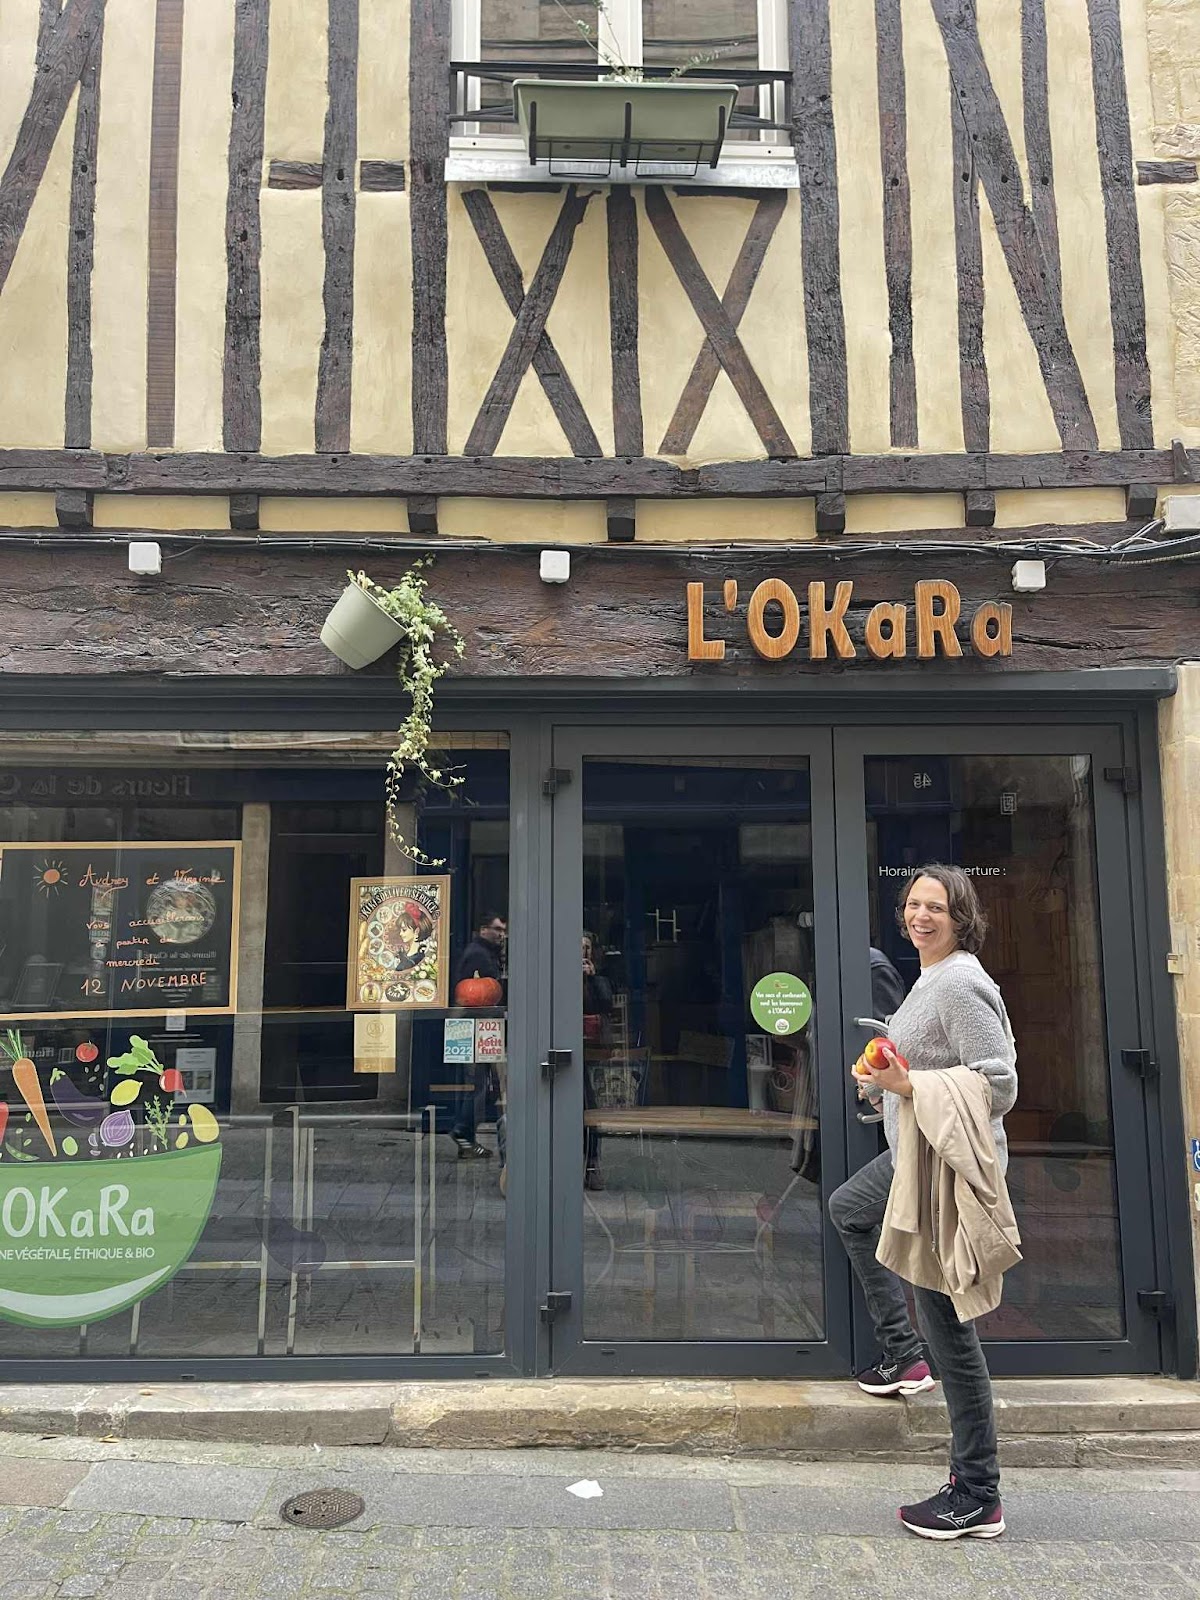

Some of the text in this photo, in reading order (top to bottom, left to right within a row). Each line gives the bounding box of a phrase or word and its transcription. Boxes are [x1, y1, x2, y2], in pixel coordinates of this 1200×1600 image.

[686, 577, 1013, 662] L'OKaRa
[79, 863, 129, 900] Audrey
[146, 873, 160, 885] et
[106, 957, 160, 968] mercredi
[80, 978, 106, 996] 12
[120, 971, 207, 993] NOVEMBRE
[479, 1021, 501, 1031] 2021
[445, 1046, 471, 1055] 2022
[2, 1184, 155, 1238] OKaRa
[16, 1247, 71, 1261] VÉGÉTALE,
[74, 1247, 122, 1260] ÉTHIQUE
[126, 1248, 135, 1258] &
[137, 1247, 155, 1258] BIO
